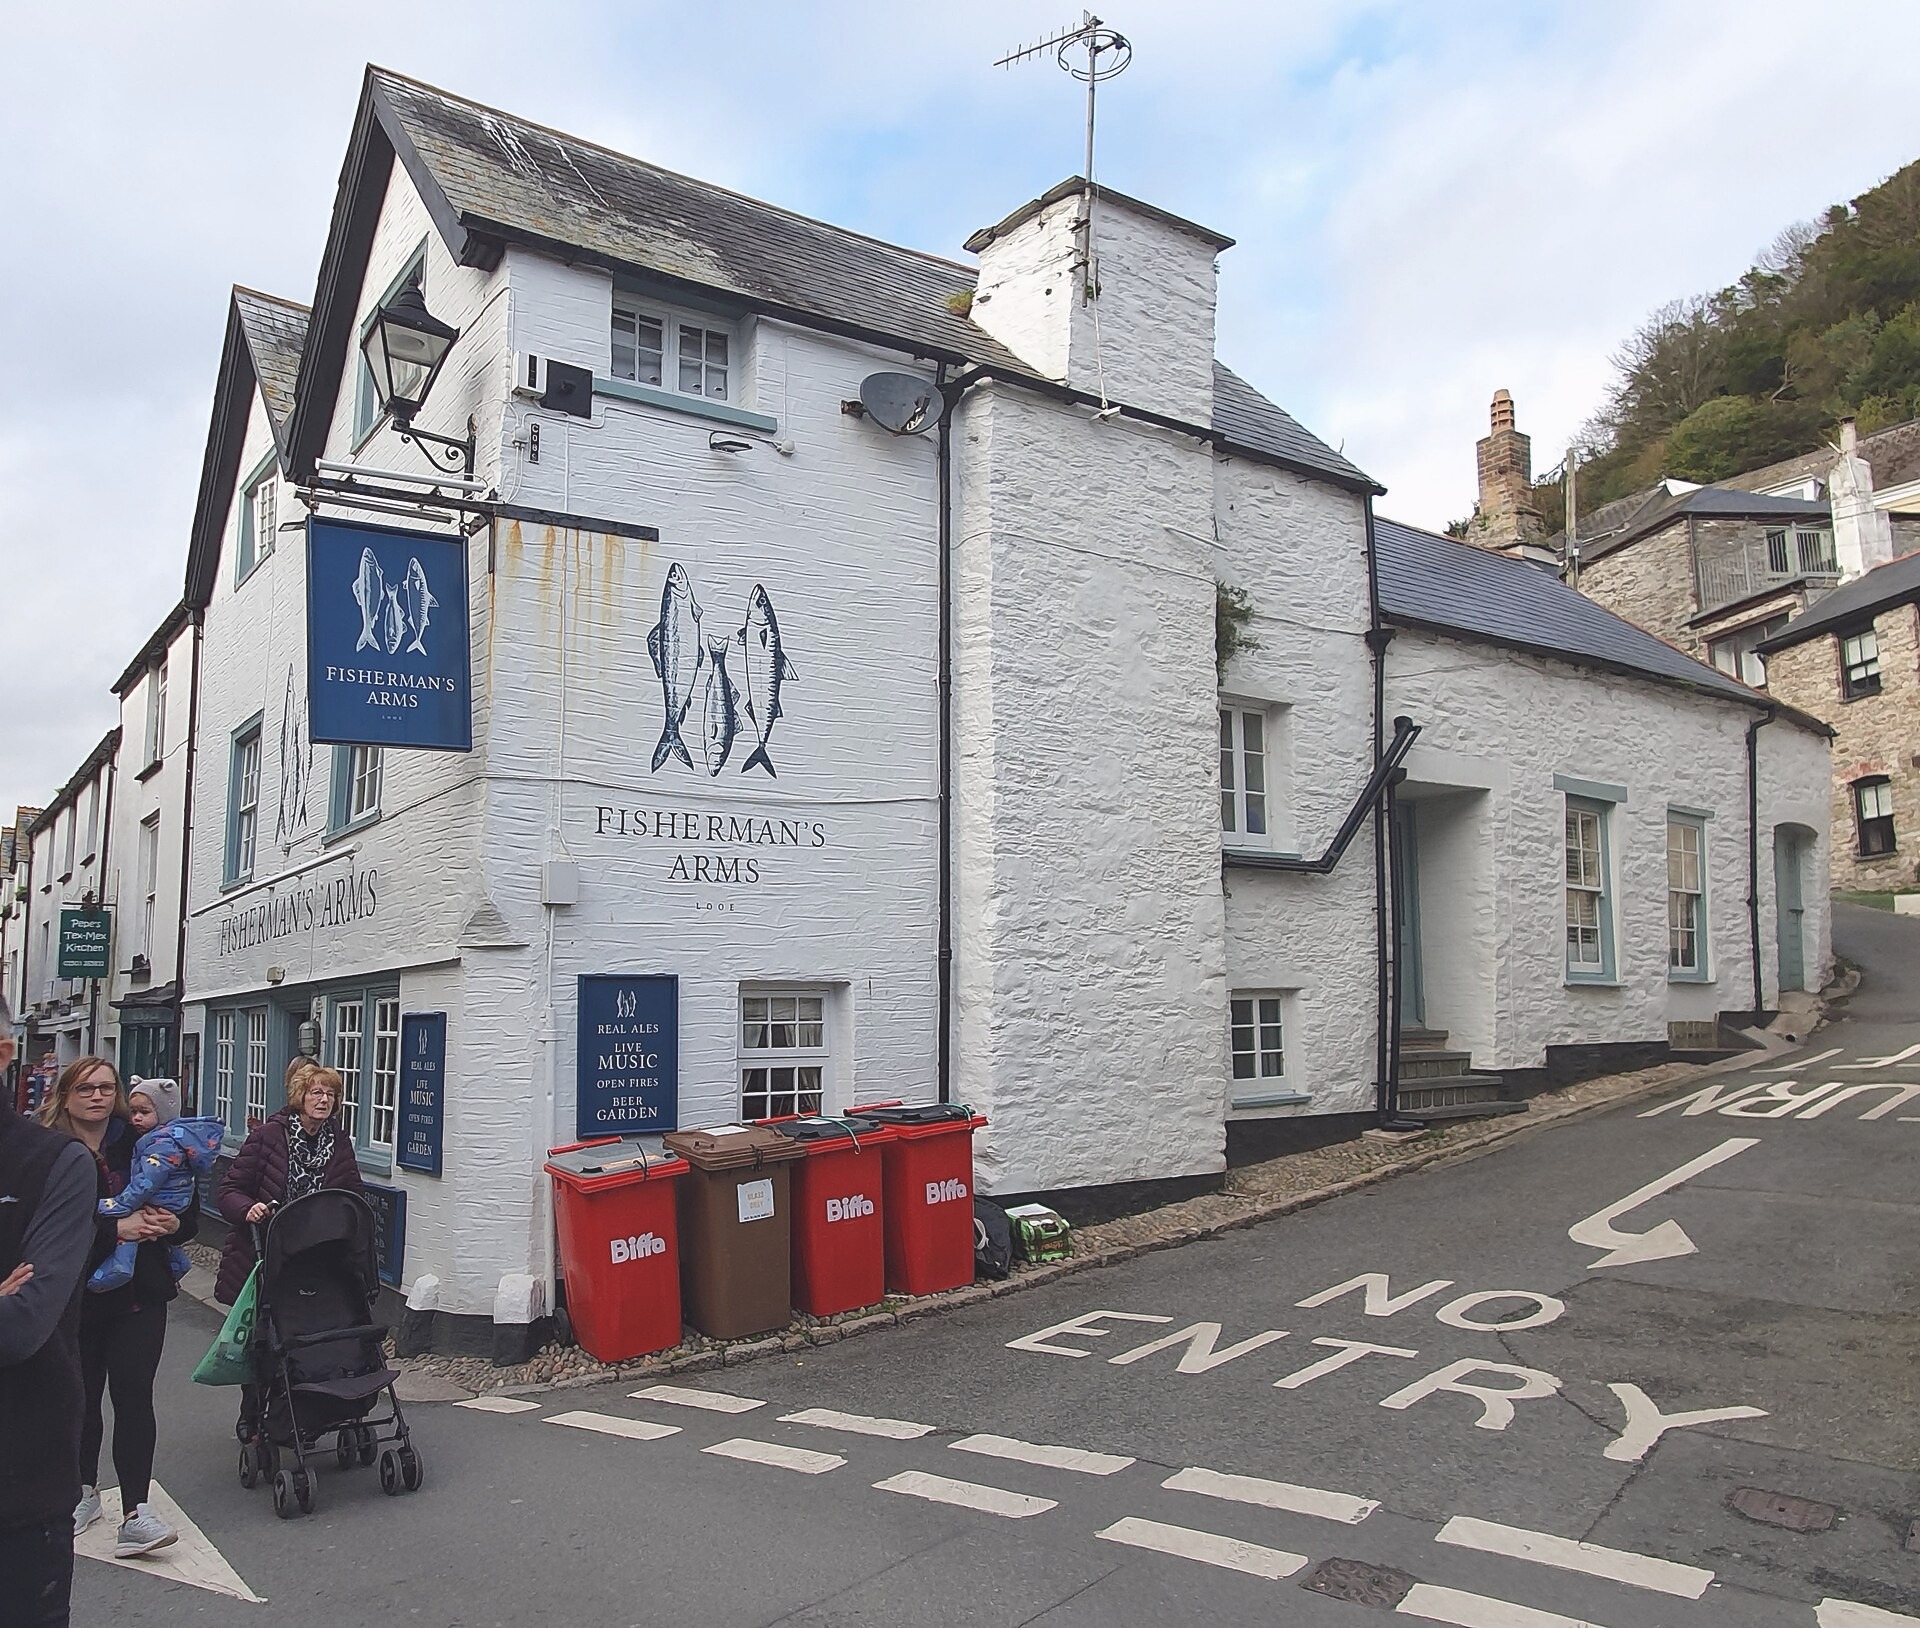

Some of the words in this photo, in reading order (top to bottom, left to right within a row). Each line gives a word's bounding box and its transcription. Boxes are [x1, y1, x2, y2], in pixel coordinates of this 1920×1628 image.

[326, 666, 456, 692] FISHERMAN'S
[366, 691, 419, 708] ARMS
[594, 806, 826, 848] FISHERMAN'S
[667, 854, 760, 883] ARMS
[219, 888, 314, 956] FISHERMAN'S
[319, 869, 378, 928] ARMS
[696, 903, 735, 912] LOOE
[63, 931, 107, 941] Tex-Mex
[65, 943, 104, 952] Kitchen
[598, 1024, 627, 1033] REAL
[631, 1023, 659, 1033] ALES
[615, 1042, 643, 1052] LIVE
[411, 1061, 423, 1070] REAL
[425, 1061, 436, 1070] ALES
[598, 1053, 658, 1069] MUSIC
[417, 1079, 428, 1089] LIVE
[597, 1079, 626, 1088] OPEN
[630, 1077, 659, 1087] FIRES
[410, 1090, 435, 1106] MUSIC
[613, 1096, 643, 1106] BEER
[421, 1114, 434, 1124] FIRES
[597, 1106, 658, 1120] GARDEN
[414, 1131, 427, 1141] BEER
[408, 1141, 433, 1155] GARDEN
[925, 1177, 967, 1205] Biffa
[826, 1193, 874, 1223] Biffa
[610, 1231, 666, 1264] Biffa
[1294, 1273, 1566, 1334] NO
[1004, 1308, 1769, 1464] ENTRY
